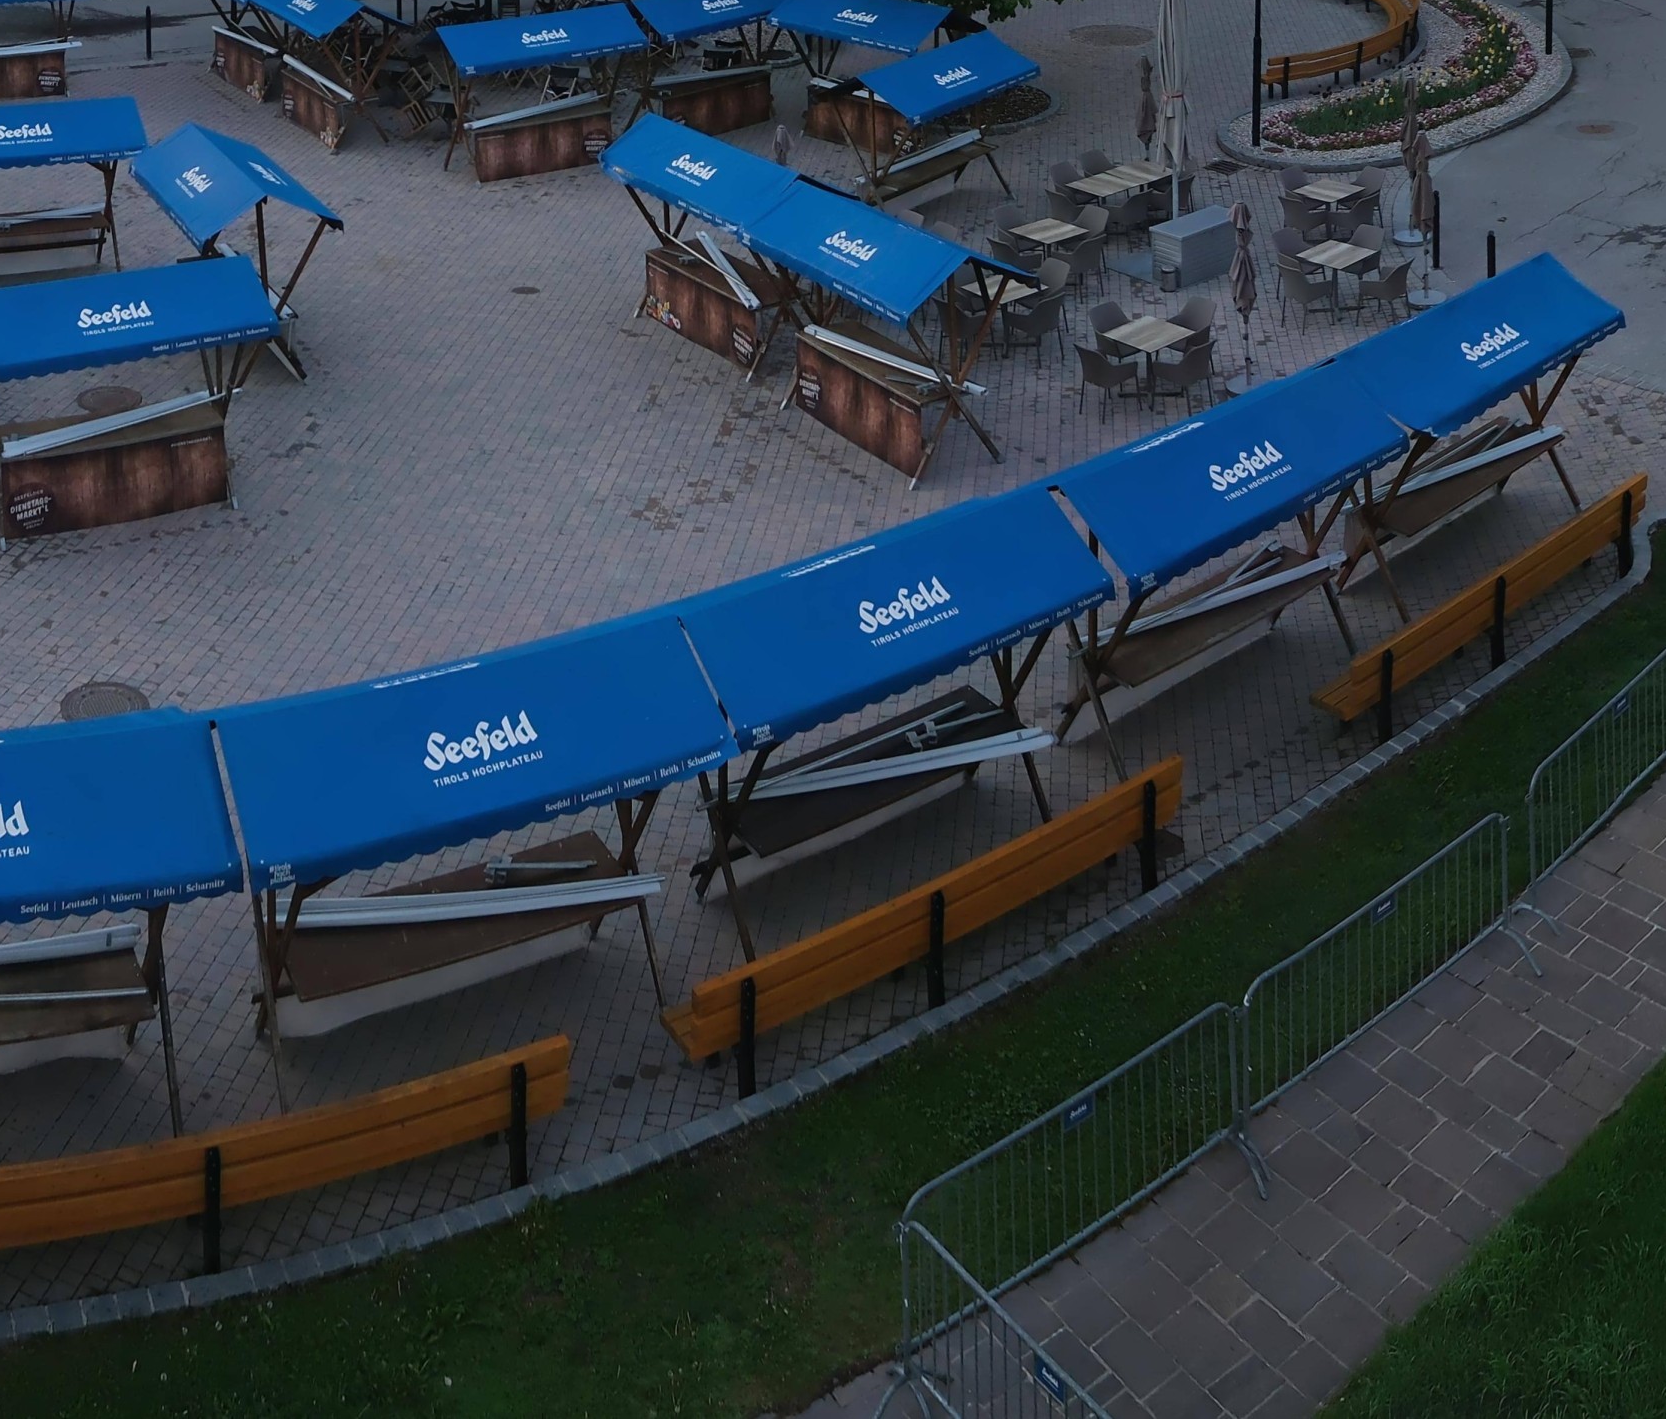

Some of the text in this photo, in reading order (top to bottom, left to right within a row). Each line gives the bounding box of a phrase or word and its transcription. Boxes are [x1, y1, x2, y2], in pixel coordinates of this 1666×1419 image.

[521, 28, 568, 44] Seefeld
[671, 153, 718, 181] Seefeld
[825, 230, 878, 262] Seefeld
[77, 300, 153, 329] Seefeld
[83, 320, 155, 337] TIROLS HOCHPLATEAU
[1461, 322, 1520, 362] Seefeld
[1209, 439, 1283, 492] Seefeld
[1223, 464, 1293, 502] TIROLS HOCHPLATEAU
[10, 496, 52, 514] DIENSTAGS-
[16, 505, 49, 521] MARKT'L
[859, 575, 951, 634] Seefeld
[871, 607, 960, 648] TIROLS HOCHPLATEAU
[423, 709, 538, 771] Seefeld
[433, 749, 544, 788] TIROLS HOCHPLATEAU
[545, 749, 722, 813] Seefeld Leutasch Mösern Reith Scharnitz
[20, 878, 226, 915] Seefeld Leutasch Mösern Reith Scharnitz
